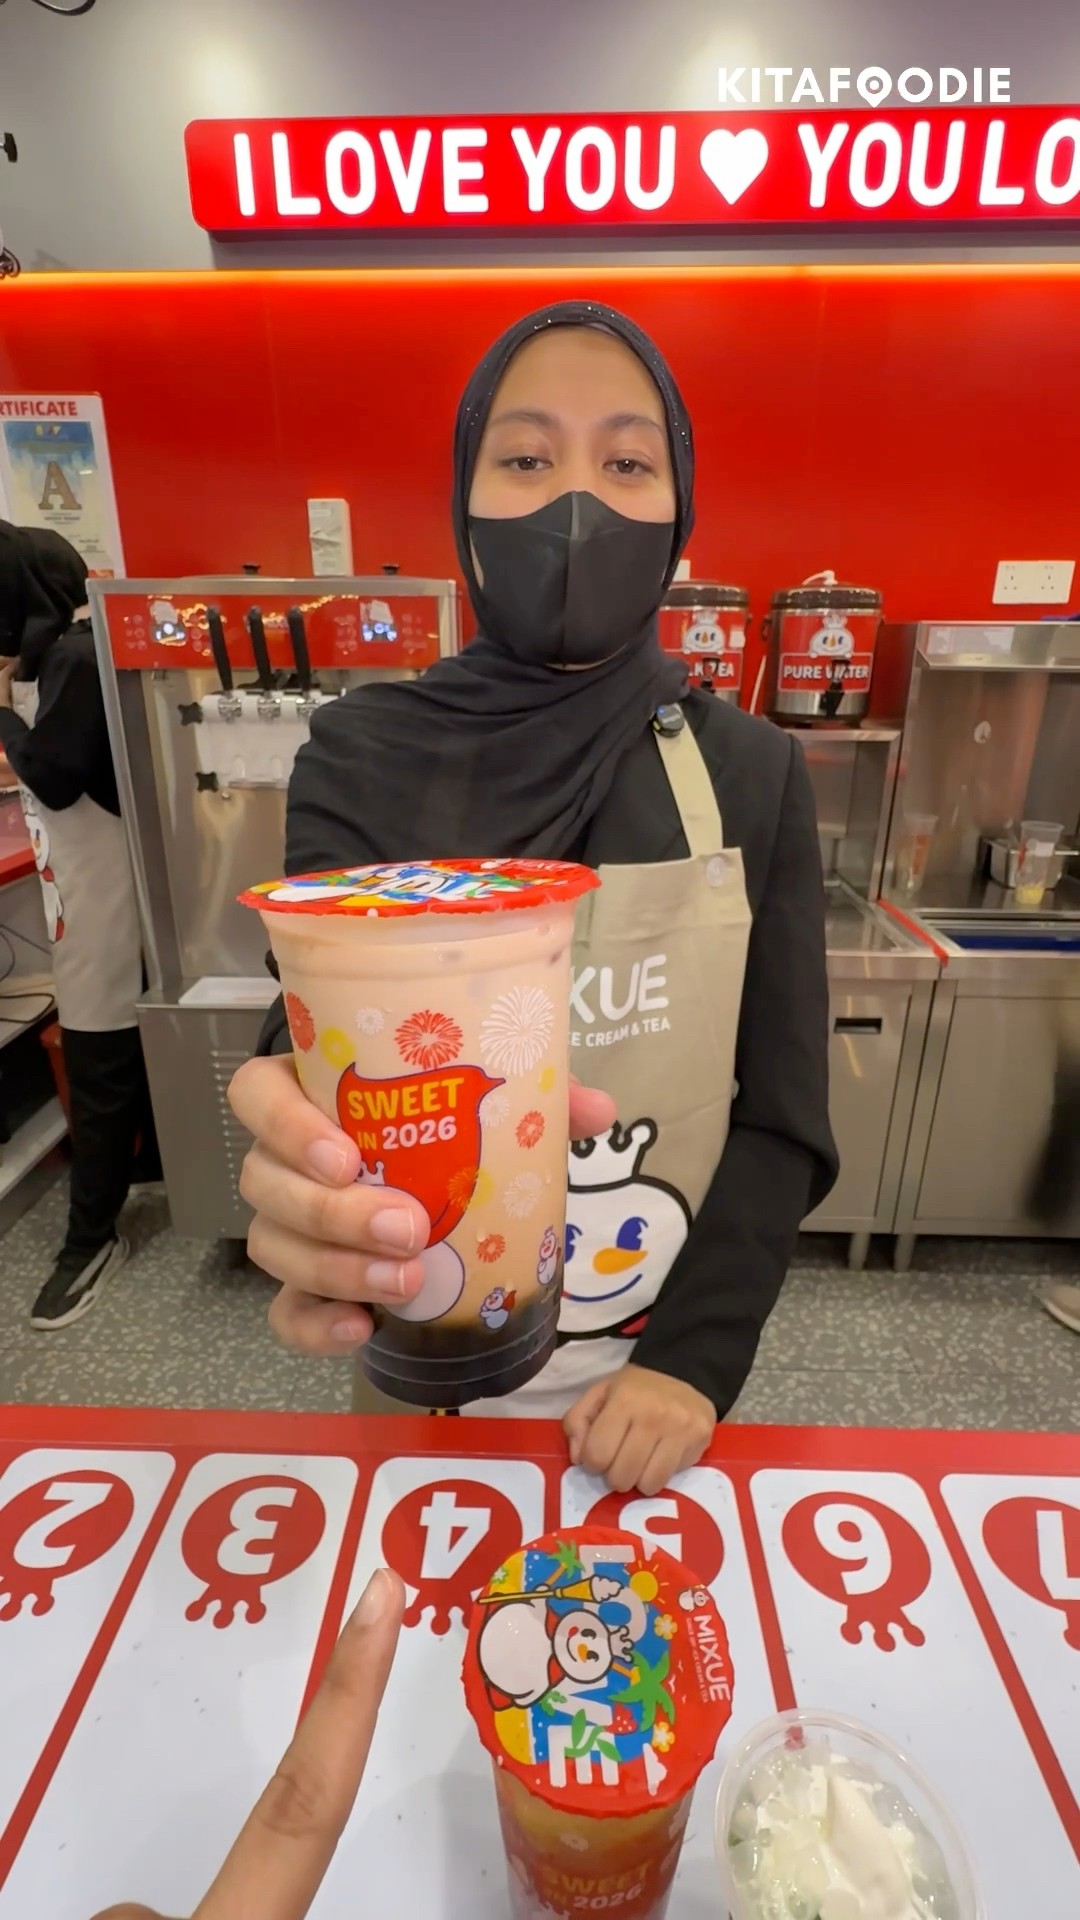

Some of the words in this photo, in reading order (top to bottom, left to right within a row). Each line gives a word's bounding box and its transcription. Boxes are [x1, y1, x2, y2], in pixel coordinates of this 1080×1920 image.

[233, 132, 256, 217] I
[271, 126, 489, 216] LOVE
[510, 124, 677, 212] YOU
[797, 119, 966, 208] YOU
[38, 460, 82, 510] A
[783, 664, 822, 679] PURE
[585, 1023, 630, 1047] CREAM
[631, 1021, 640, 1036] &
[642, 1016, 671, 1033] TEA
[347, 1077, 464, 1120] SWEET
[357, 1131, 377, 1150] IN
[382, 1115, 457, 1150] 2026
[13, 1481, 114, 1569] 2
[216, 1486, 298, 1576] 3
[419, 1490, 491, 1580] 4
[813, 1503, 893, 1596] 6
[693, 1614, 731, 1702] MIXUE
[572, 1882, 643, 1909] 2026
